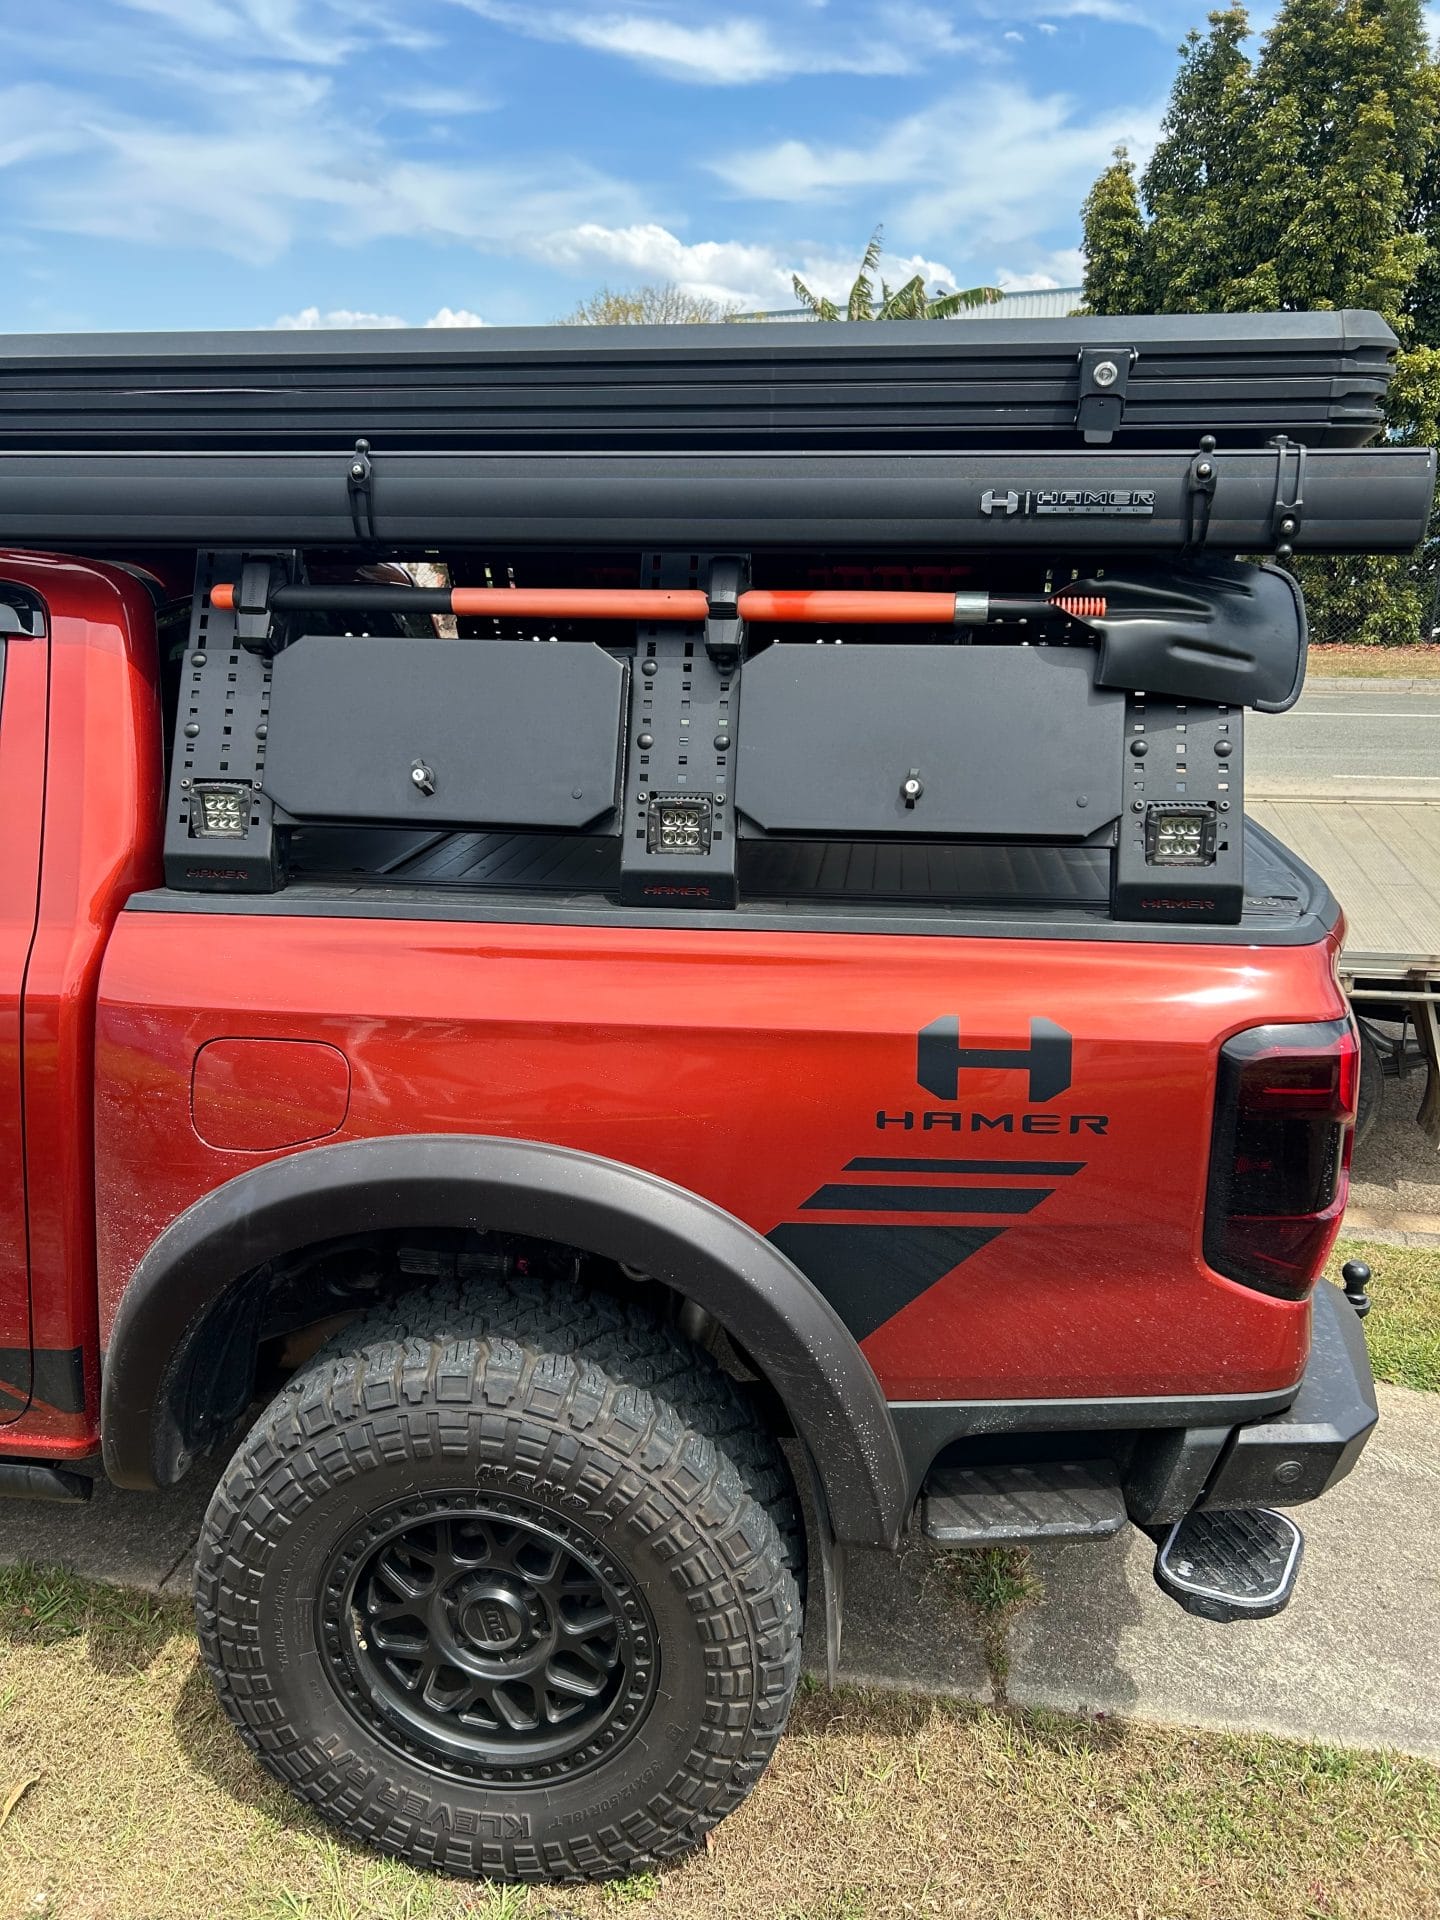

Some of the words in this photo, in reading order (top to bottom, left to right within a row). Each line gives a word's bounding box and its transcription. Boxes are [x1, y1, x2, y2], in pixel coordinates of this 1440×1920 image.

[1037, 490, 1155, 505] HAMER
[186, 869, 249, 880] HAMER
[643, 886, 710, 896] HAMER
[1142, 899, 1215, 910] HAMER
[876, 1110, 1109, 1135] HAMER
[376, 1775, 532, 1840] KLEVER
